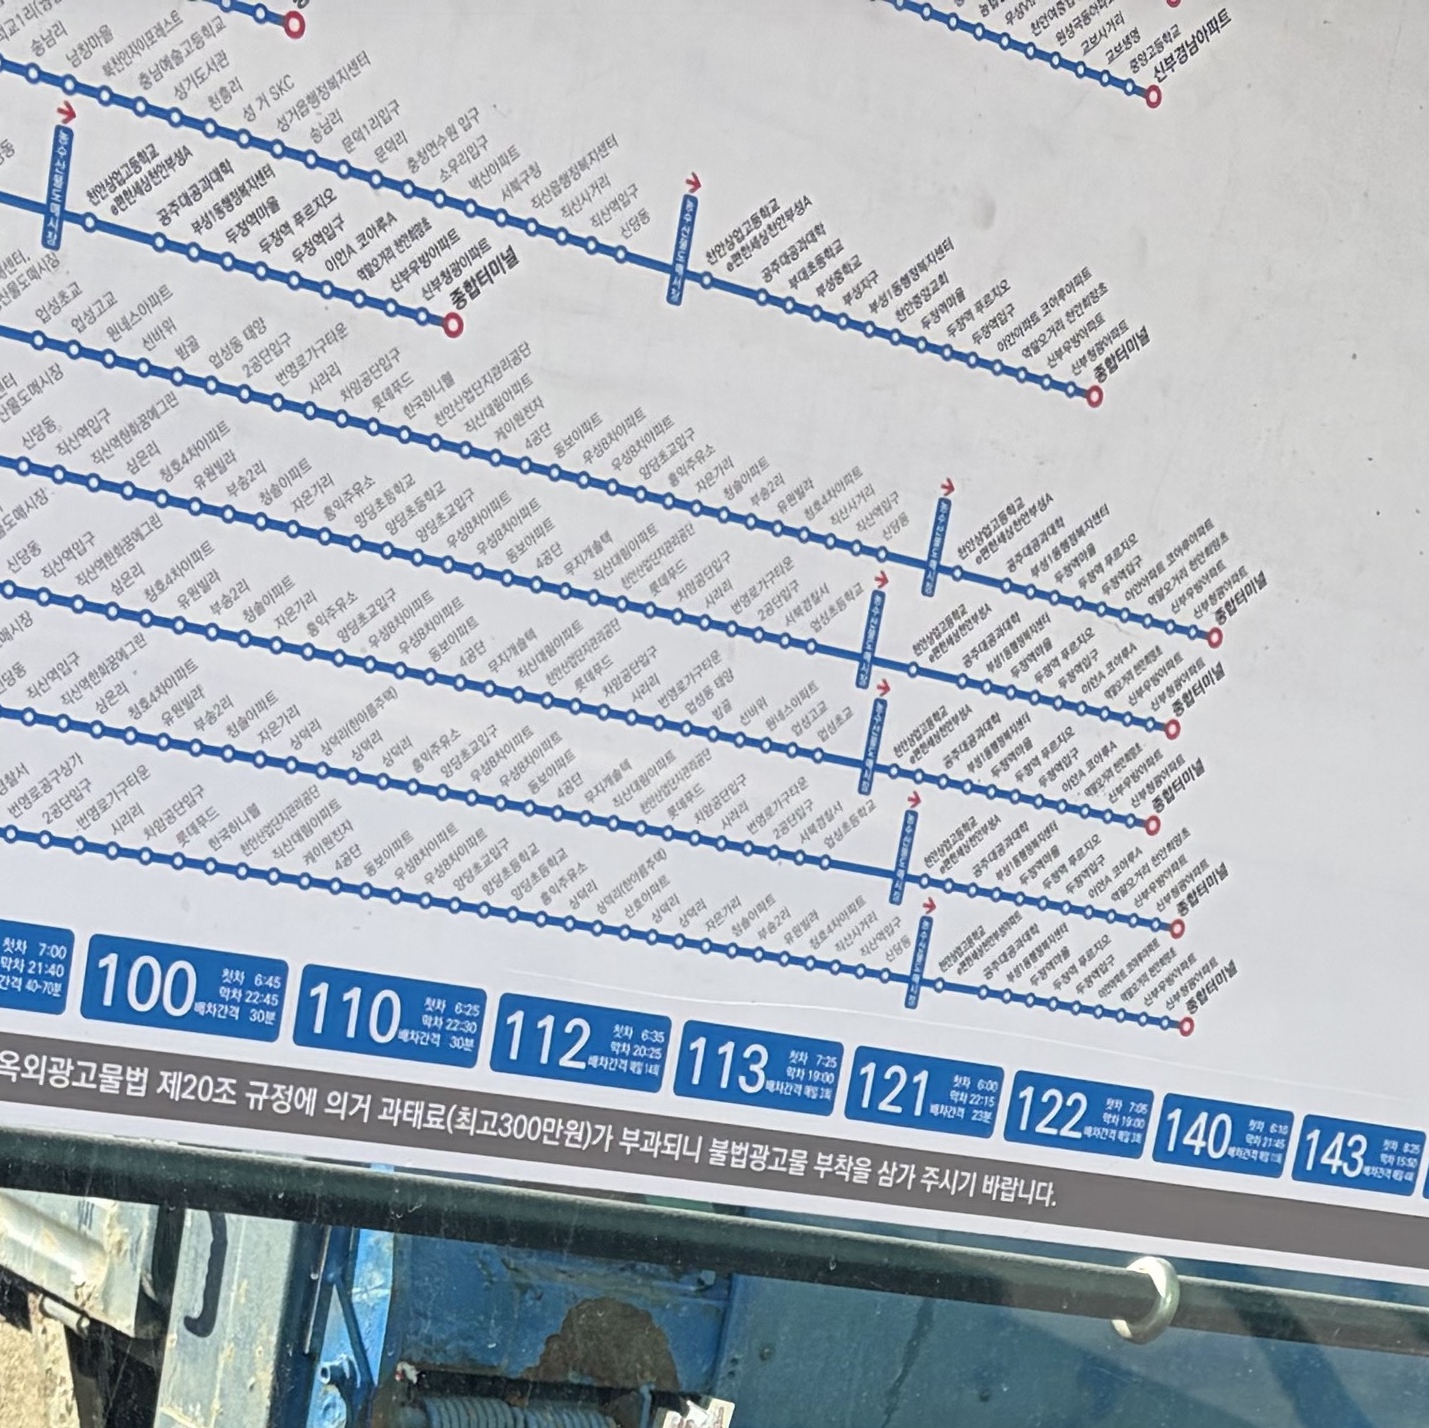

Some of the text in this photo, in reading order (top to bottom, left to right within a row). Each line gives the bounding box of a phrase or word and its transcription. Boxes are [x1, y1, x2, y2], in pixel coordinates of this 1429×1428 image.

[1153, 8, 1233, 84] 신부경남아파트
[449, 244, 520, 311] 종합터미널
[99, 953, 196, 1016] 100
[245, 990, 278, 1006] 22:45
[254, 974, 281, 988] 6:45
[310, 982, 400, 1043] 110
[507, 1011, 590, 1069] 112
[690, 1037, 768, 1093] 113
[860, 1062, 928, 1116] 121
[156, 1070, 236, 1104] 제20조
[244, 1080, 317, 1116] 규정에
[324, 1090, 372, 1123] 의거
[377, 1097, 613, 1153] 과태료(최고300만원)가
[618, 1127, 702, 1163] 부과되니
[708, 1137, 807, 1176] 불법광고물
[813, 1151, 871, 1184] 부착을
[877, 1160, 915, 1190] 삼가
[920, 1166, 976, 1197] 주시기
[981, 1174, 1056, 1206] 바랍니다.
[1019, 1086, 1086, 1138] 122
[1168, 1109, 1231, 1158] 140
[1307, 1129, 1367, 1177] 143
